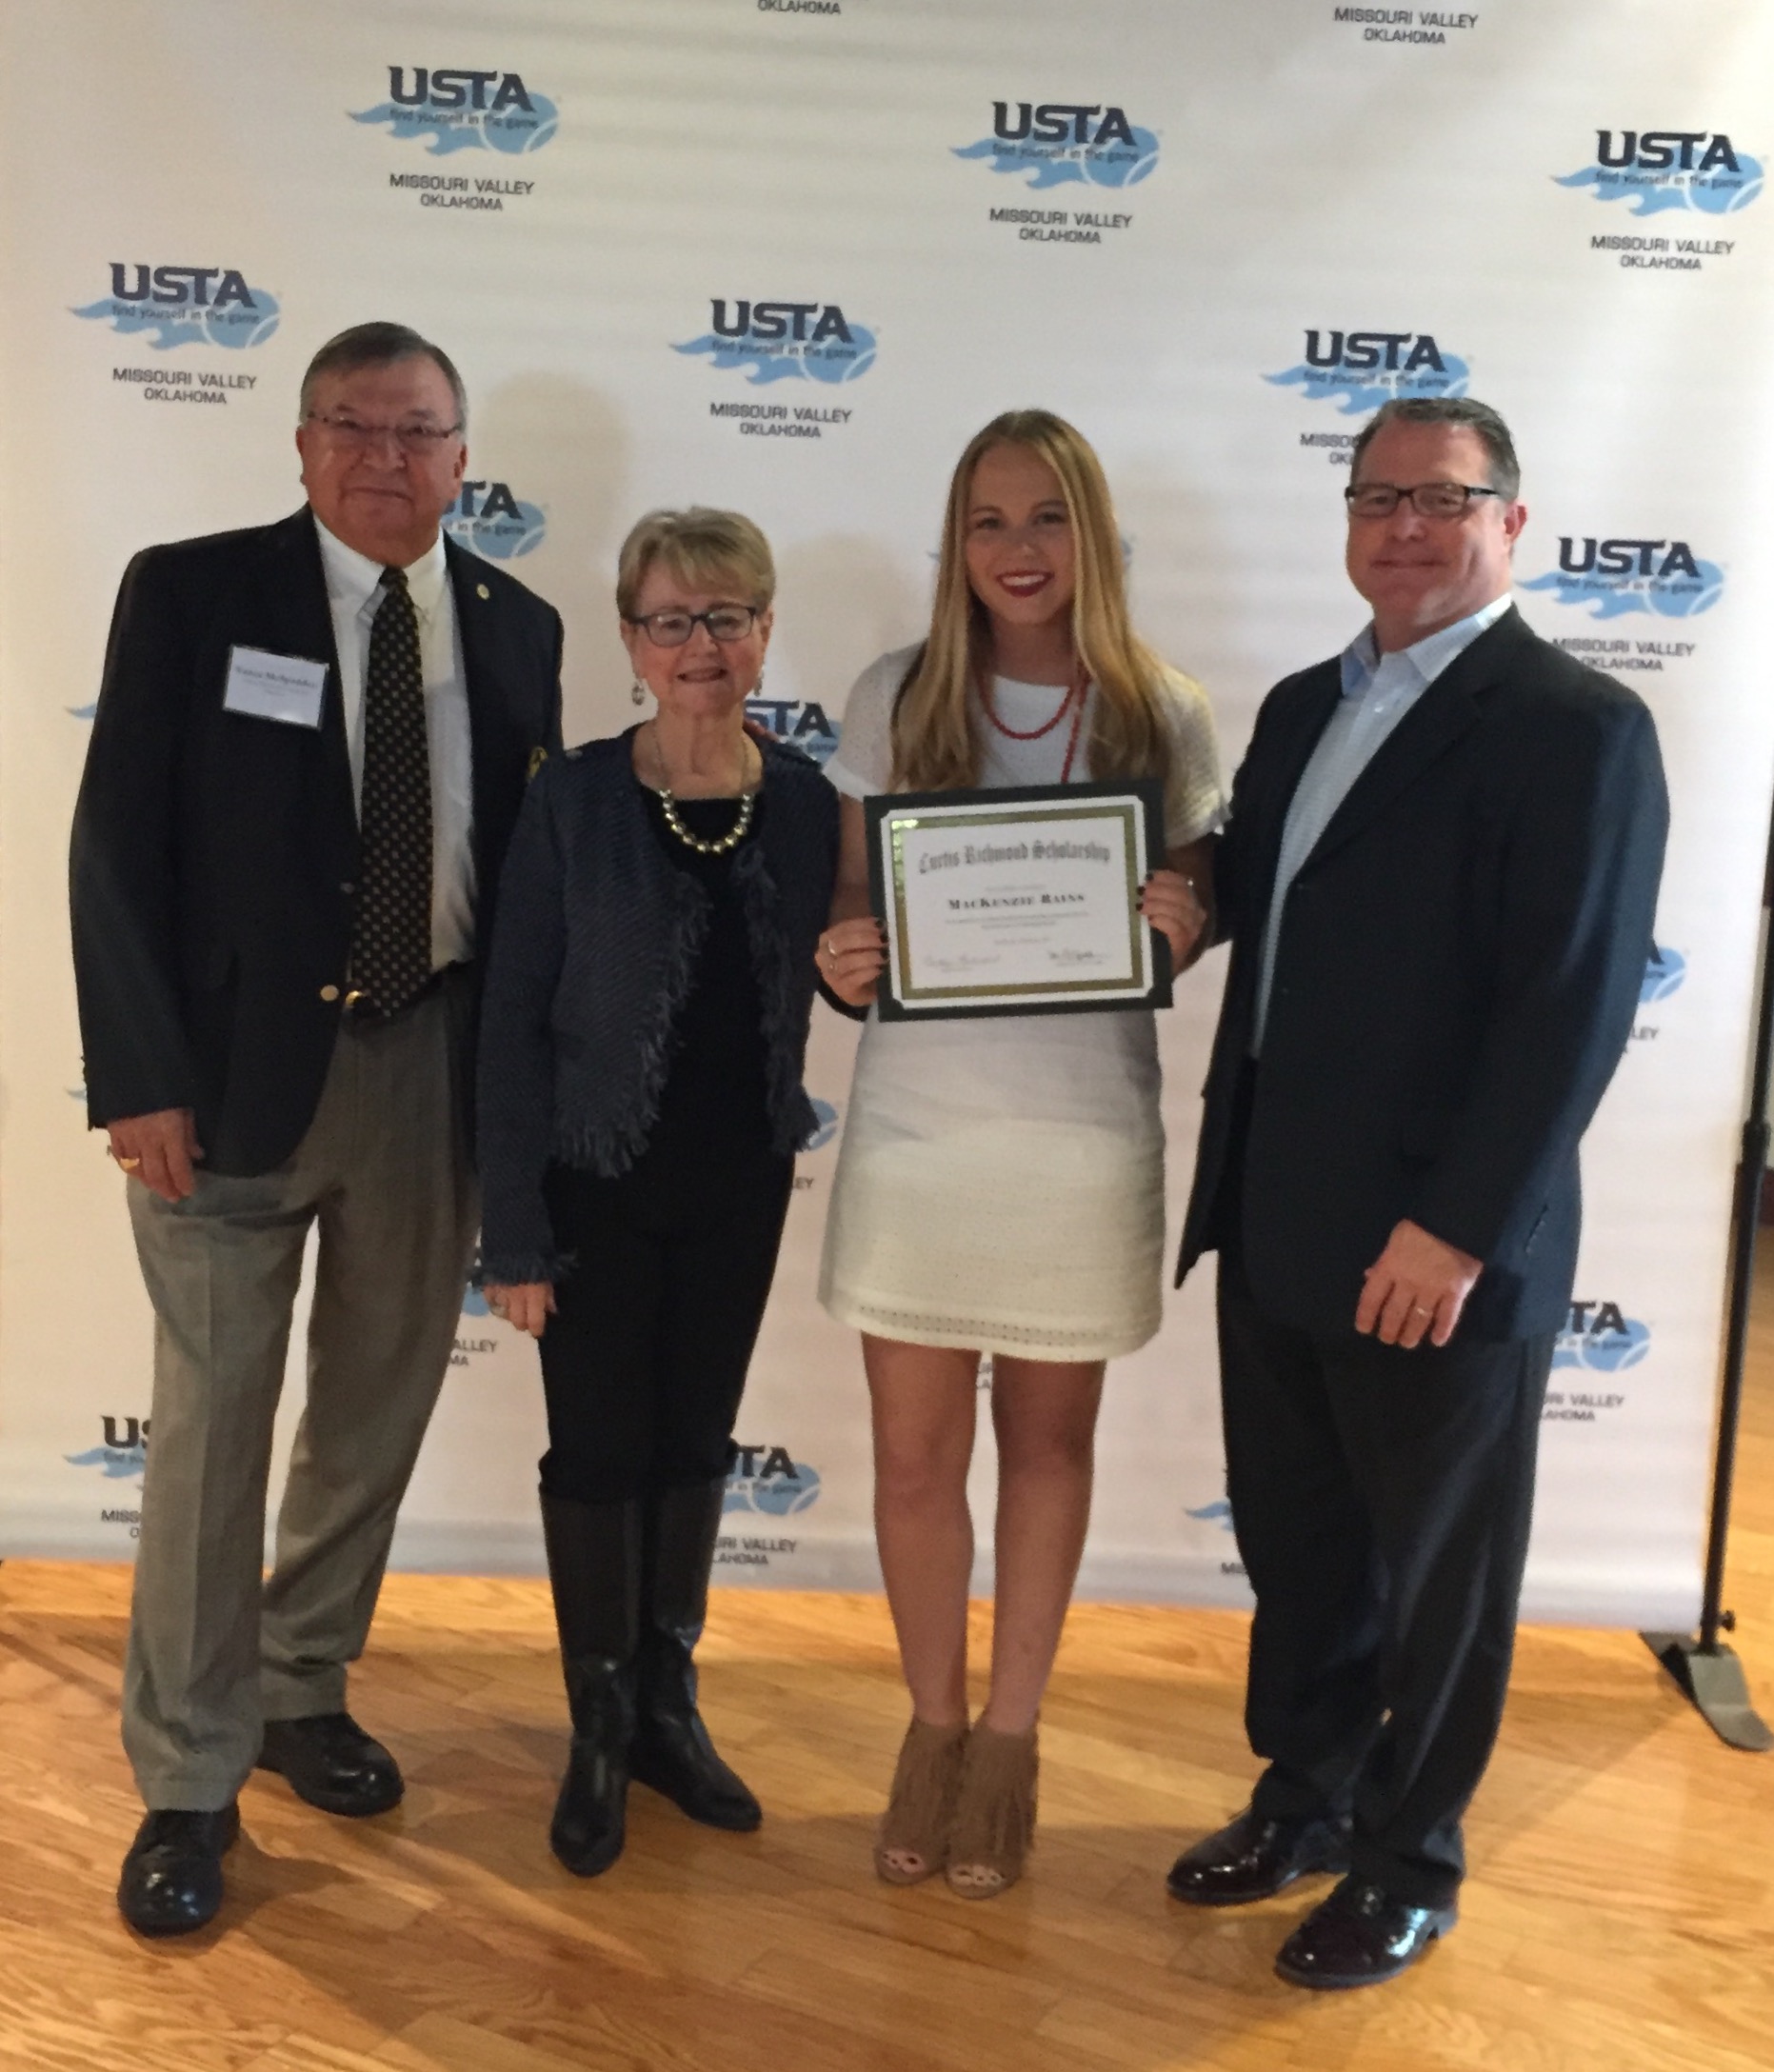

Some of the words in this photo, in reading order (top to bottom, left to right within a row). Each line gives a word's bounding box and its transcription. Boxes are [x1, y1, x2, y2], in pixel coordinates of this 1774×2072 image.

[758, 0, 841, 14] OKLAHOMA
[1333, 8, 1413, 25] MISSOURI
[1420, 11, 1479, 29] VALLEY
[1364, 28, 1445, 44] OKLAHOMA
[388, 65, 535, 112] USTA
[390, 110, 413, 120] find
[417, 112, 463, 125] yourself
[468, 114, 479, 124] in
[484, 115, 503, 126] the
[506, 118, 539, 130] game
[991, 101, 1138, 146] USTA
[1596, 130, 1742, 172] USTA
[389, 173, 468, 191] MISSOURI
[474, 178, 535, 194] VALLEY
[420, 193, 504, 210] OKLAHOMA
[989, 208, 1067, 225] MISSOURI
[1074, 212, 1133, 229] VALLEY
[1019, 228, 1102, 244] OKLAHOMA
[1591, 235, 1669, 252] MISSOURI
[1675, 240, 1735, 255] VALLEY
[1620, 254, 1703, 270] OKLAHOMA
[109, 262, 257, 309] USTA
[112, 306, 136, 316] find
[141, 308, 186, 319] yourself
[190, 309, 202, 319] in
[206, 309, 225, 322] the
[229, 313, 259, 325] game
[710, 299, 855, 344] USTA
[1305, 329, 1447, 372] USTA
[112, 368, 191, 386] MISSOURI
[198, 373, 257, 389] VALLEY
[144, 388, 227, 404] OKLAHOMA
[710, 403, 787, 419] MISSOURI
[794, 408, 852, 423] VALLEY
[740, 422, 822, 438] OKLAHOMA
[461, 481, 523, 520] TA
[1559, 537, 1702, 578] USTA
[1553, 638, 1629, 653] MISSOURI
[1636, 642, 1696, 657] VALLEY
[1582, 656, 1664, 671] OKLAHOMA
[965, 841, 1028, 865] Richmond
[1031, 839, 1110, 865] Scholarship
[1572, 1301, 1630, 1335] TA
[454, 1339, 496, 1352] ALLEY
[1570, 1393, 1625, 1407] VALLEY
[1544, 1409, 1595, 1422] AHOMA
[736, 1444, 799, 1479] TA
[742, 1537, 797, 1553] VALLEY
[716, 1552, 768, 1565] AHOMA
